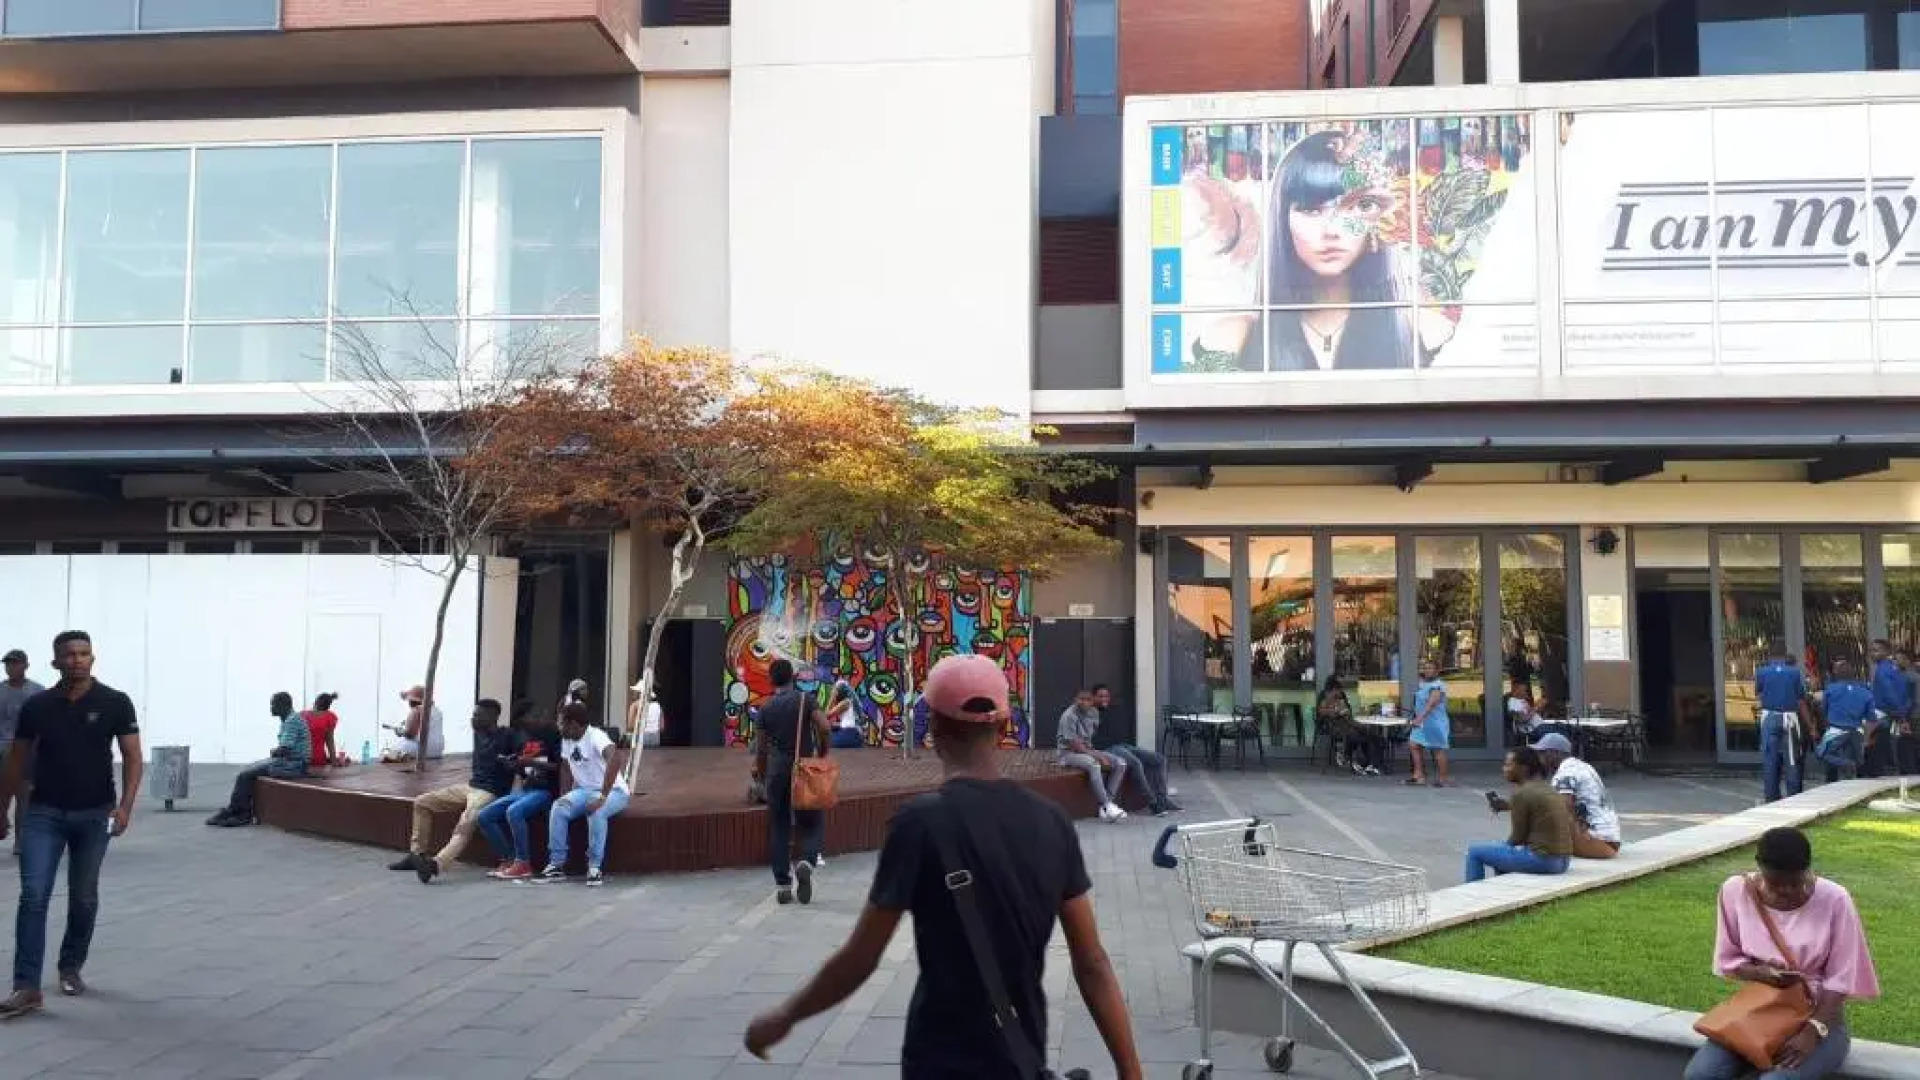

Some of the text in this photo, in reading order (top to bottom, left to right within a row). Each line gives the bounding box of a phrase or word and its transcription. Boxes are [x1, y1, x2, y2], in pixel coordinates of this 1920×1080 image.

[1606, 196, 1917, 267] I am my
[168, 499, 317, 528] TOPFLO
